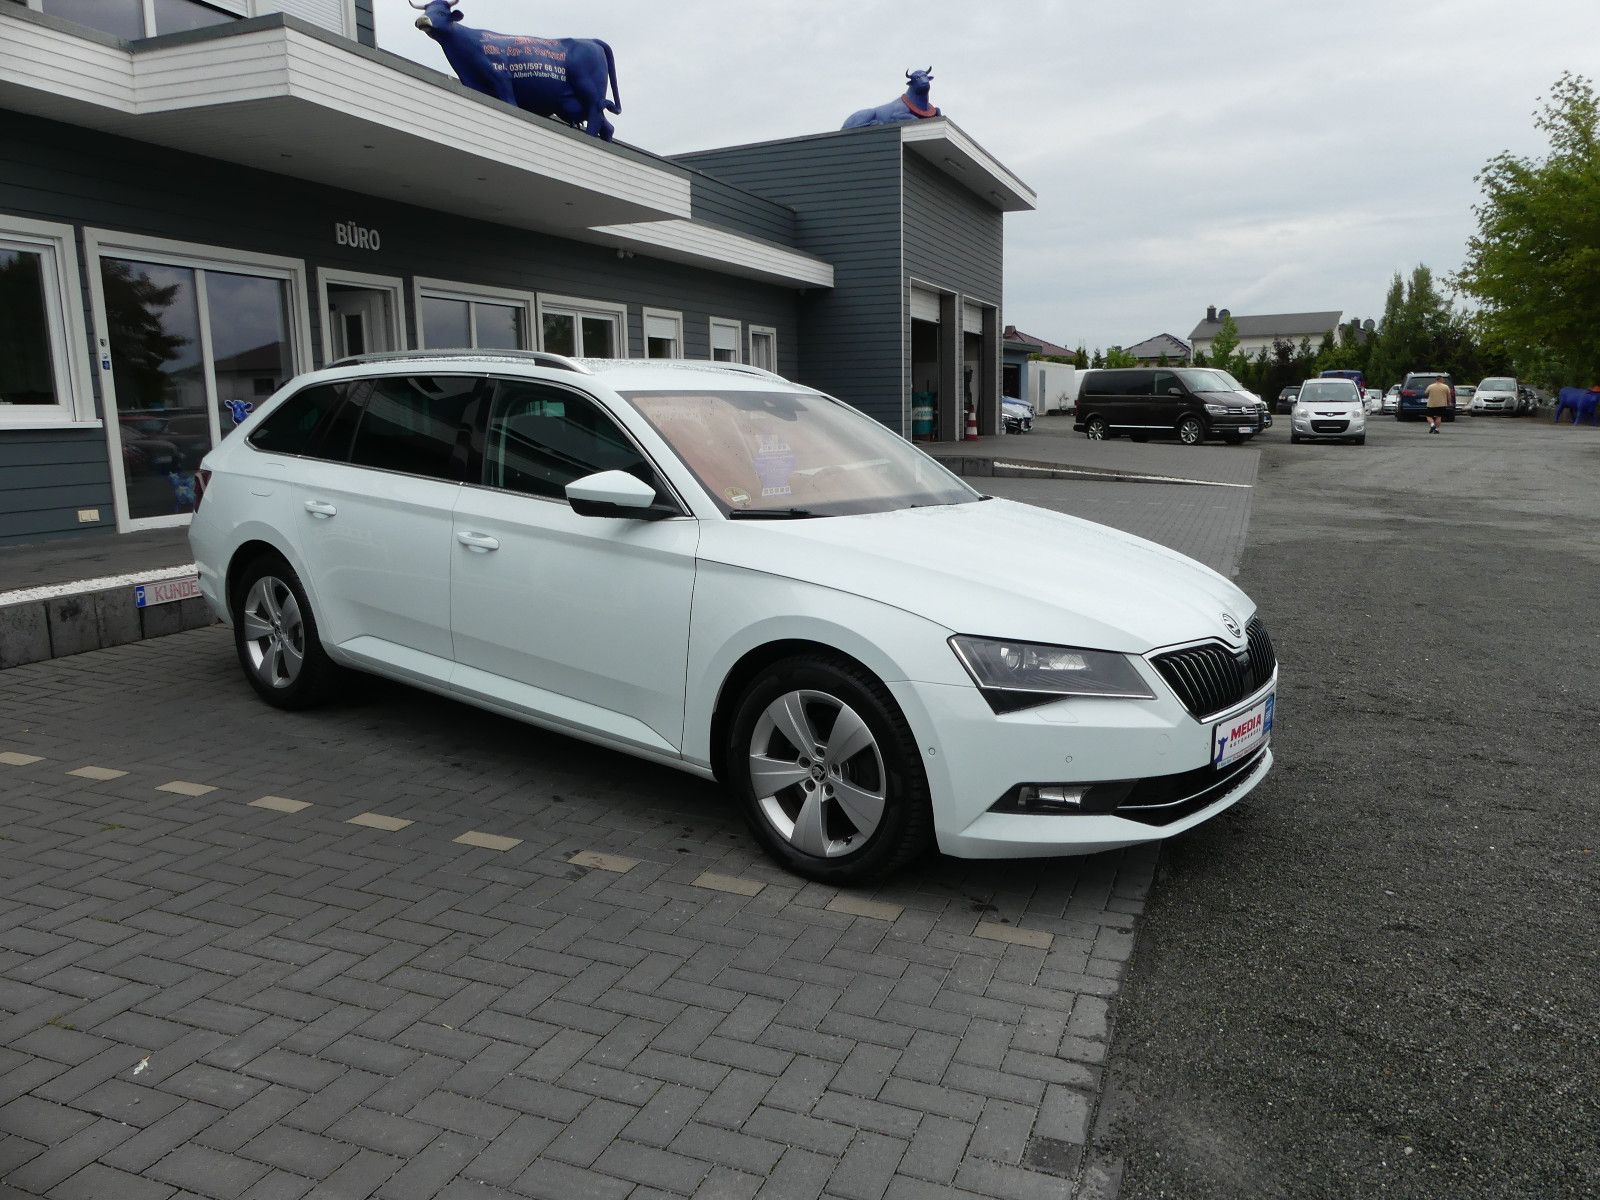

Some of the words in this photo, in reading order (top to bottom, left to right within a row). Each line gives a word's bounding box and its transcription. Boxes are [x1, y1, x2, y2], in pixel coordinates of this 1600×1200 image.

[493, 62, 507, 71] Tel.
[509, 62, 543, 72] 0391/597
[554, 66, 566, 75] 100
[335, 220, 381, 251] BÜRO
[136, 590, 145, 603] P
[154, 580, 198, 602] KUNDE
[1231, 713, 1261, 741] MEDIA
